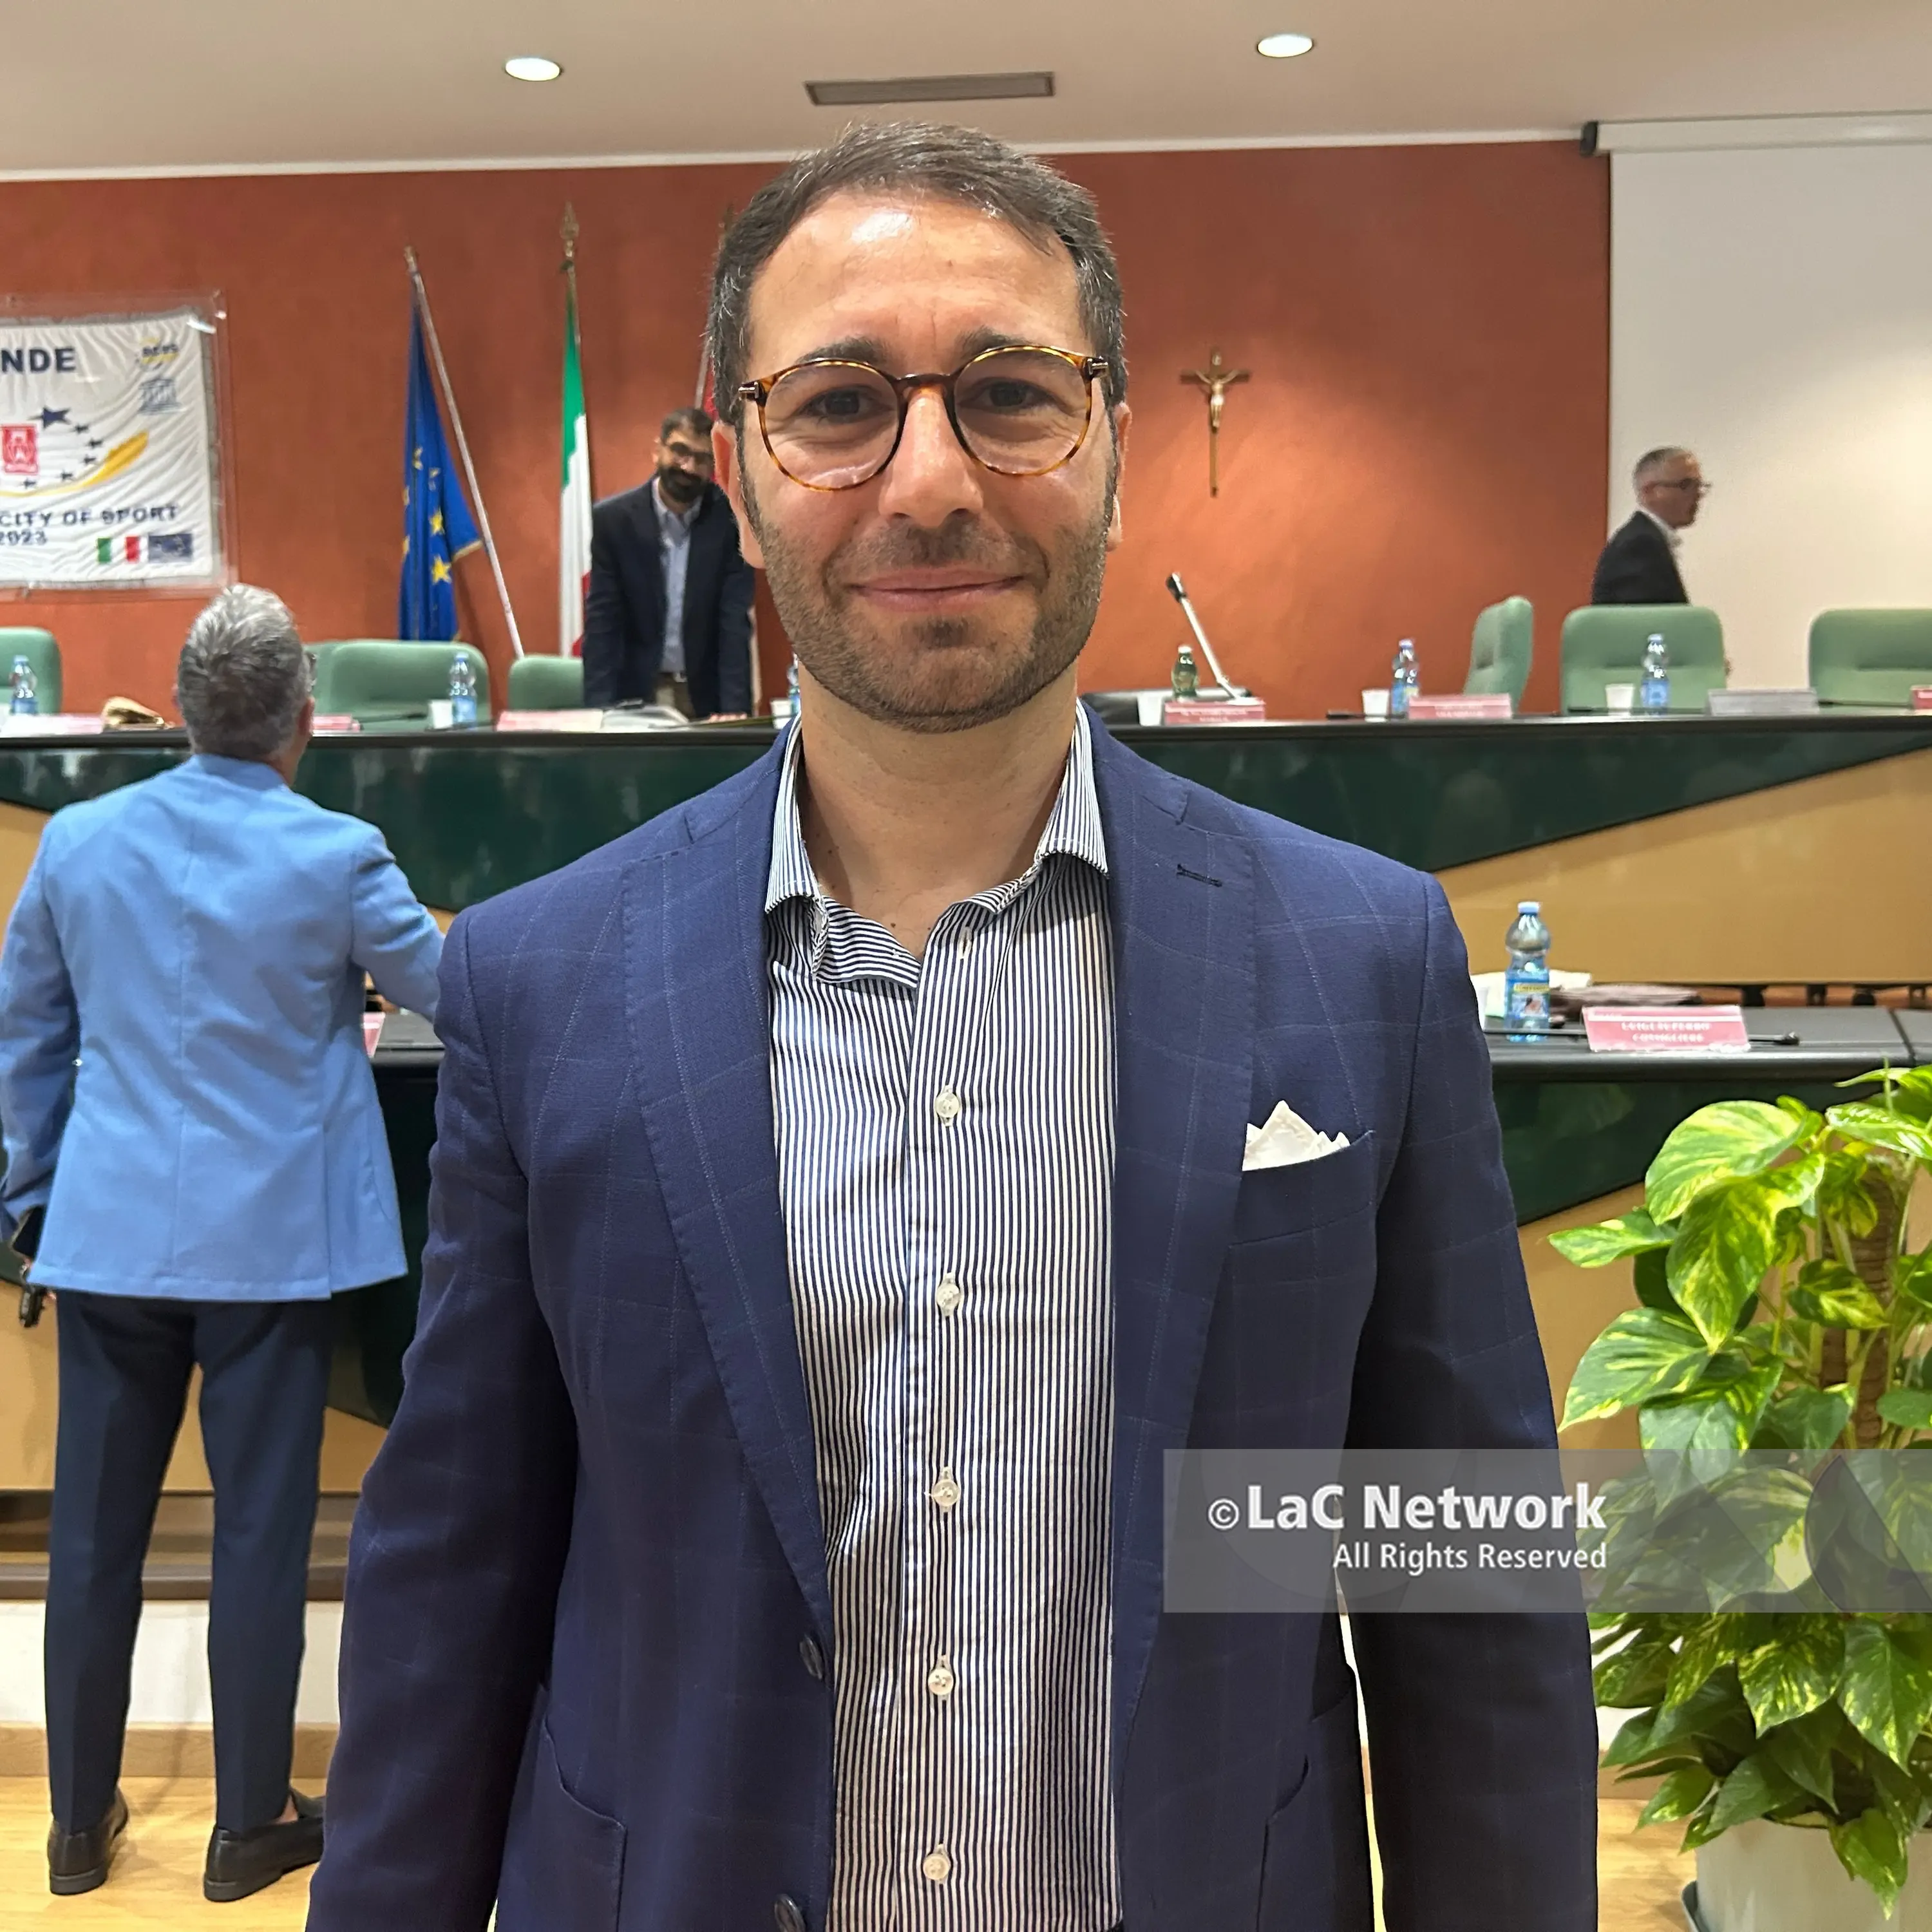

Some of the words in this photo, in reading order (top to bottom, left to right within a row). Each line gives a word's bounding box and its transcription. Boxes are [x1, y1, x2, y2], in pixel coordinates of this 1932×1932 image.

[1, 347, 76, 373] NDE
[0, 511, 52, 527] CITY
[63, 509, 91, 526] OF
[101, 506, 177, 525] SPORT
